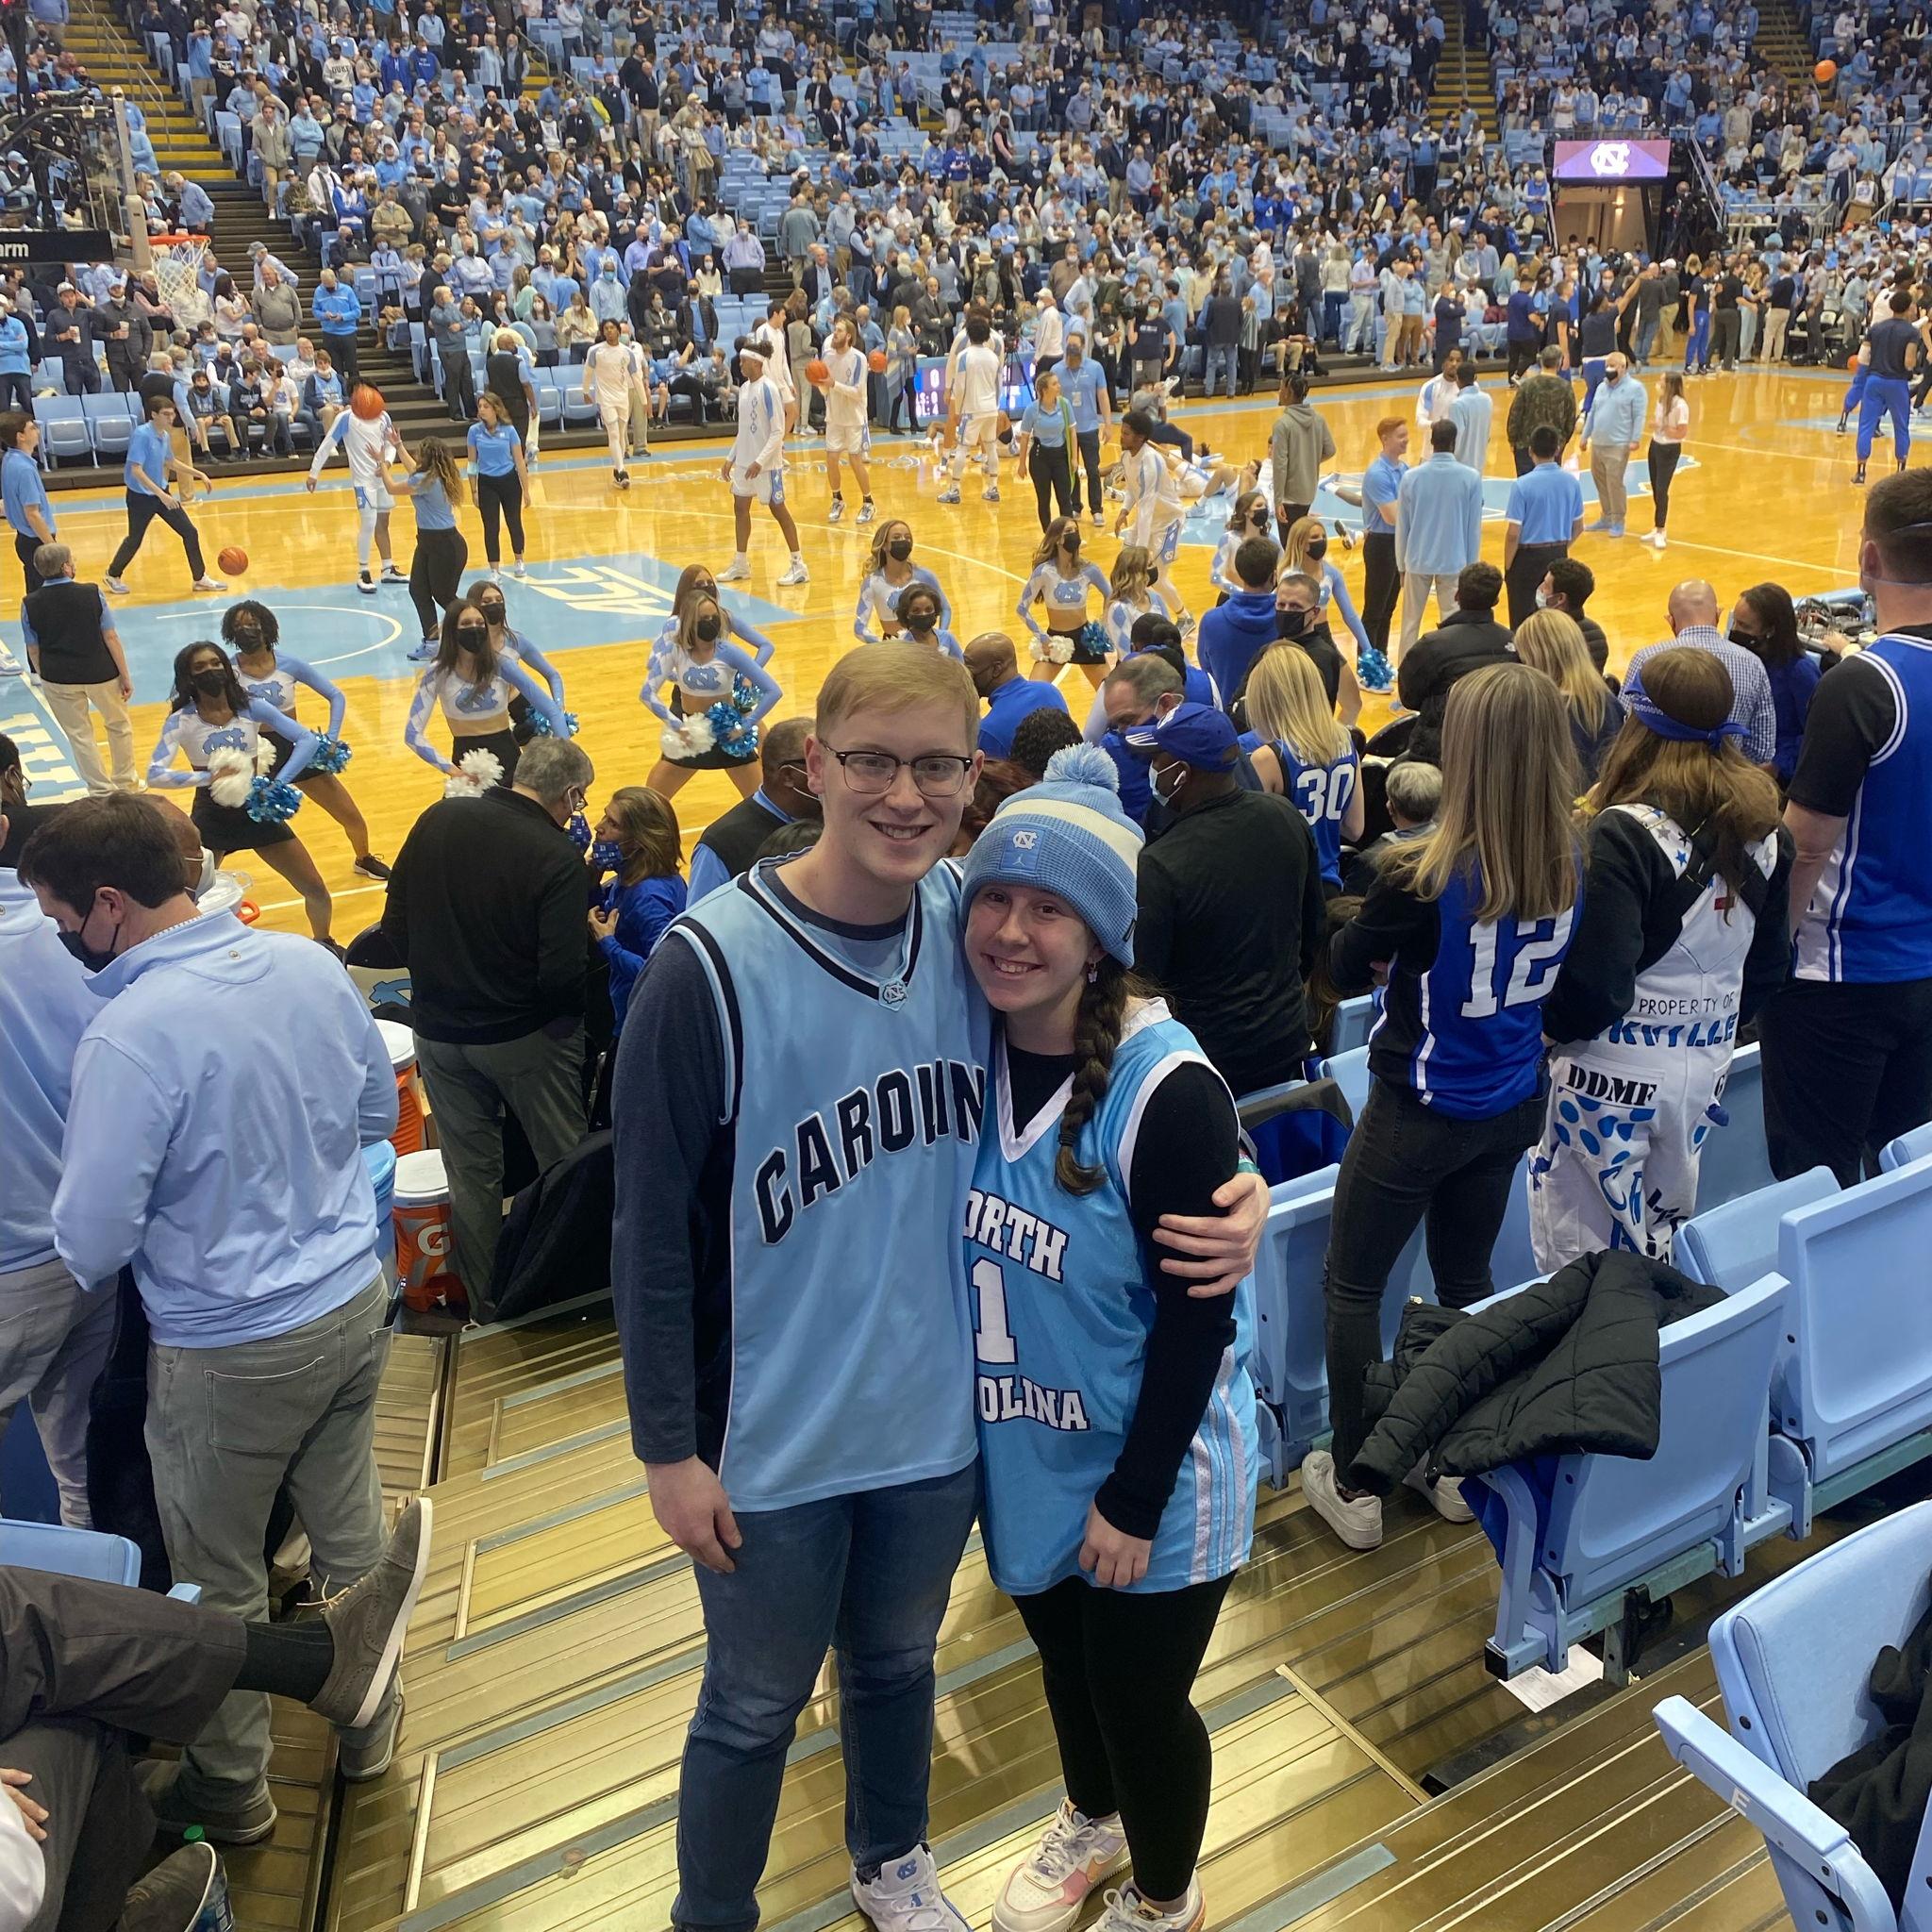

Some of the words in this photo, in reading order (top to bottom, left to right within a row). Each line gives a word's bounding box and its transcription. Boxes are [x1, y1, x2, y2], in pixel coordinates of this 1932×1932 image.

[1297, 763, 1356, 826] 30
[1461, 906, 1574, 1019] 12
[1639, 997, 1719, 1016] PROPERTY
[417, 1223, 452, 1257] G
[1730, 1787, 1751, 1818] E
